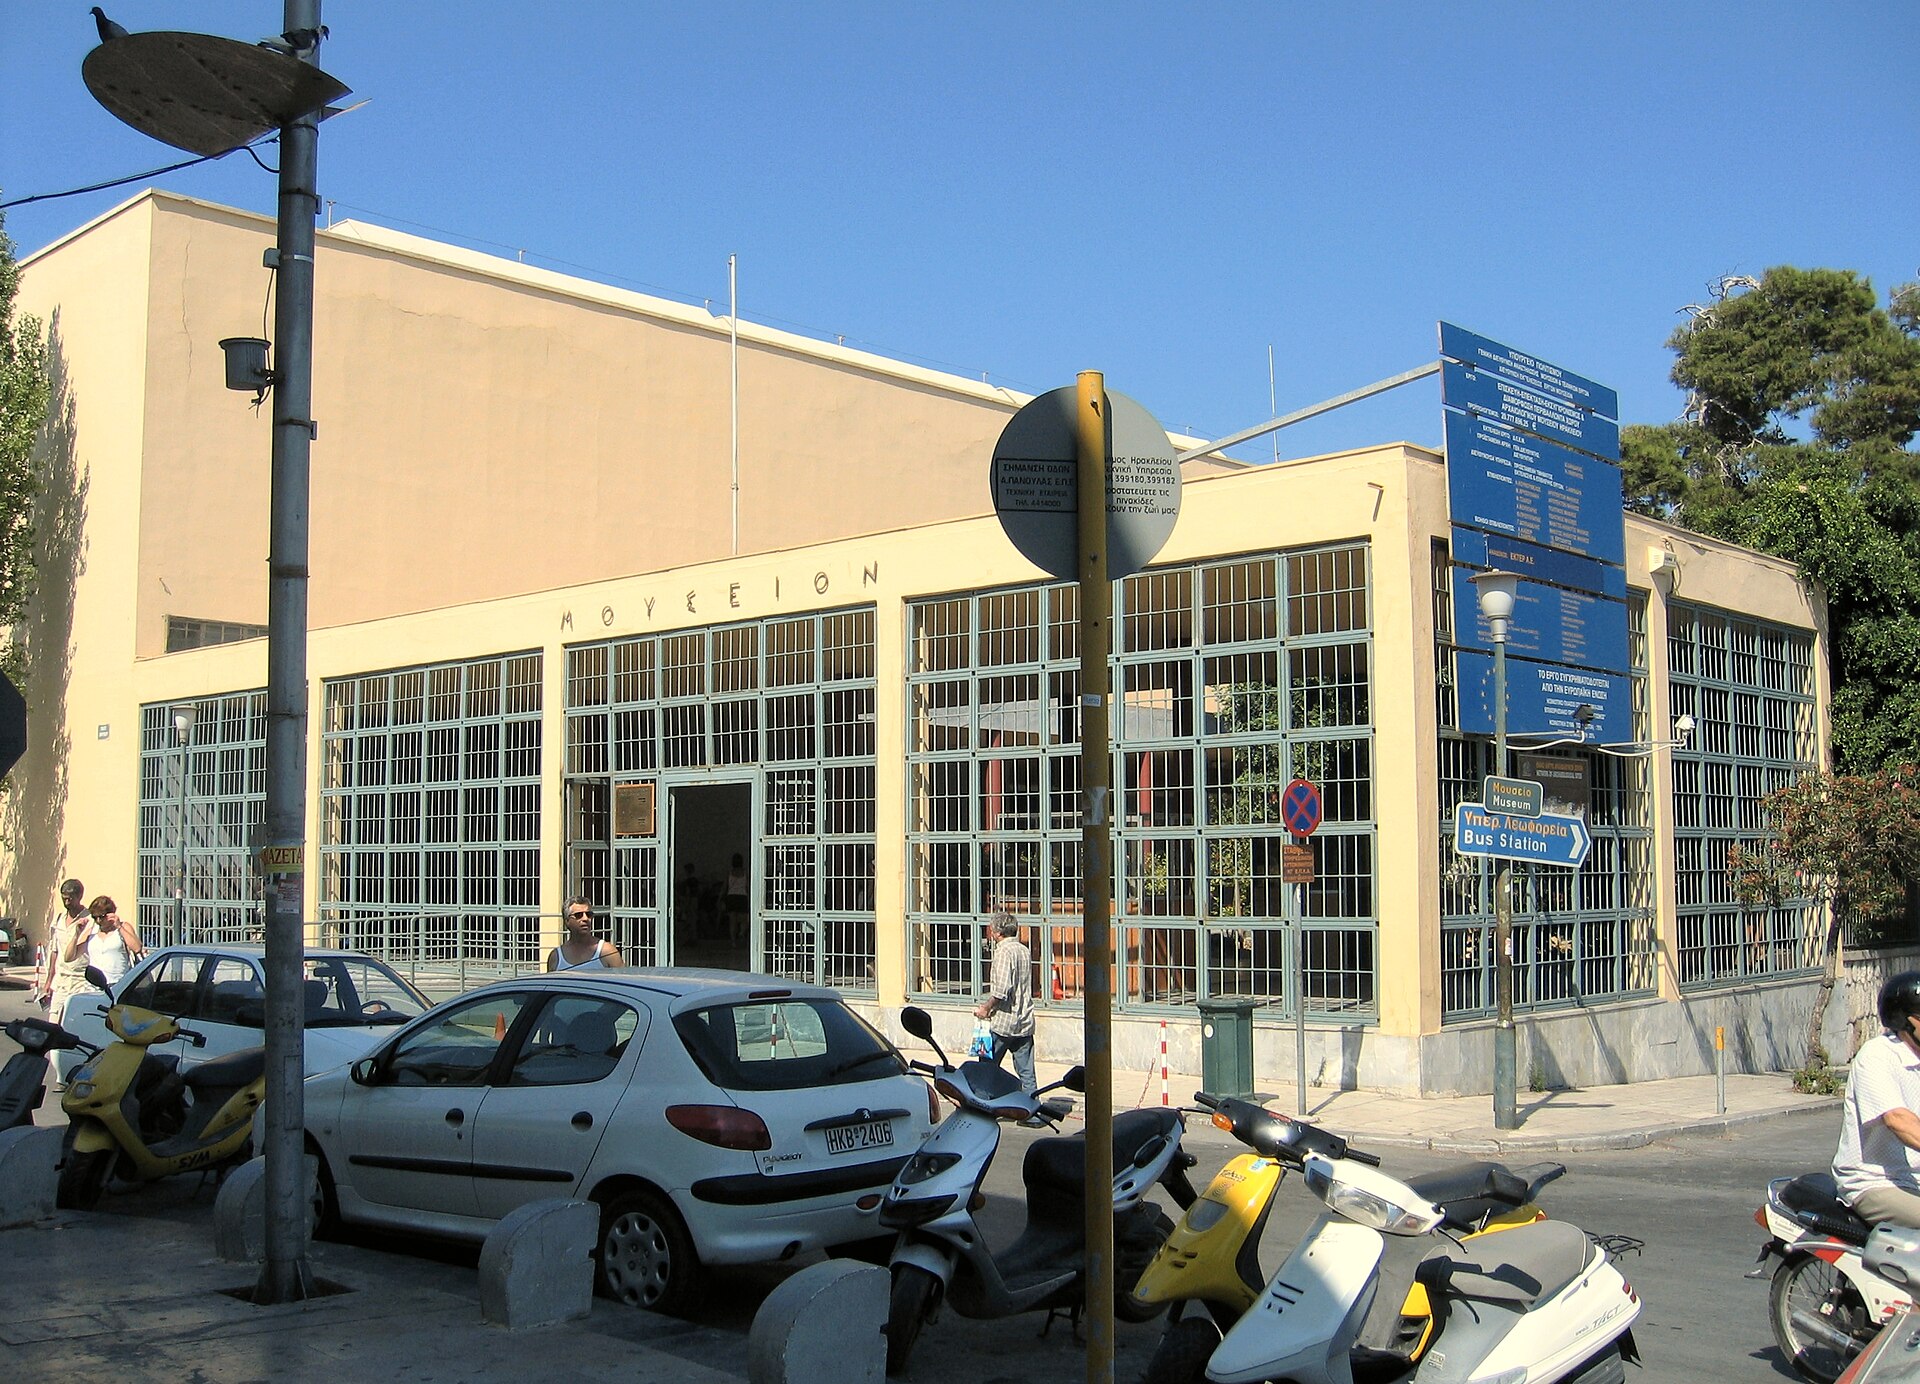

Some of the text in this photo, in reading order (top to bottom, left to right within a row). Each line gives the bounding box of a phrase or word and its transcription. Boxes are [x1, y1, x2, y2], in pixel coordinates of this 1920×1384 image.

[1130, 456, 1172, 466] Ηρακλείου
[1003, 463, 1071, 473] ΣΗΜΑΝΣΗ ΟΔΩΝ
[1136, 466, 1172, 475] Υπηρεσία
[1105, 487, 1170, 497] ροστατεύετε τις
[1116, 496, 1155, 506] πινακίδες
[560, 560, 878, 633] ΜΟΥΣΕΙΟΝ
[1546, 671, 1560, 682] ΕΡΓΟ
[1541, 682, 1554, 692] ΑΠΟ
[1492, 794, 1531, 811] Museum
[1464, 810, 1569, 838] Υπερ. Λεωφορεία
[1464, 829, 1547, 853] Bus Station
[178, 1150, 210, 1169] SYM
